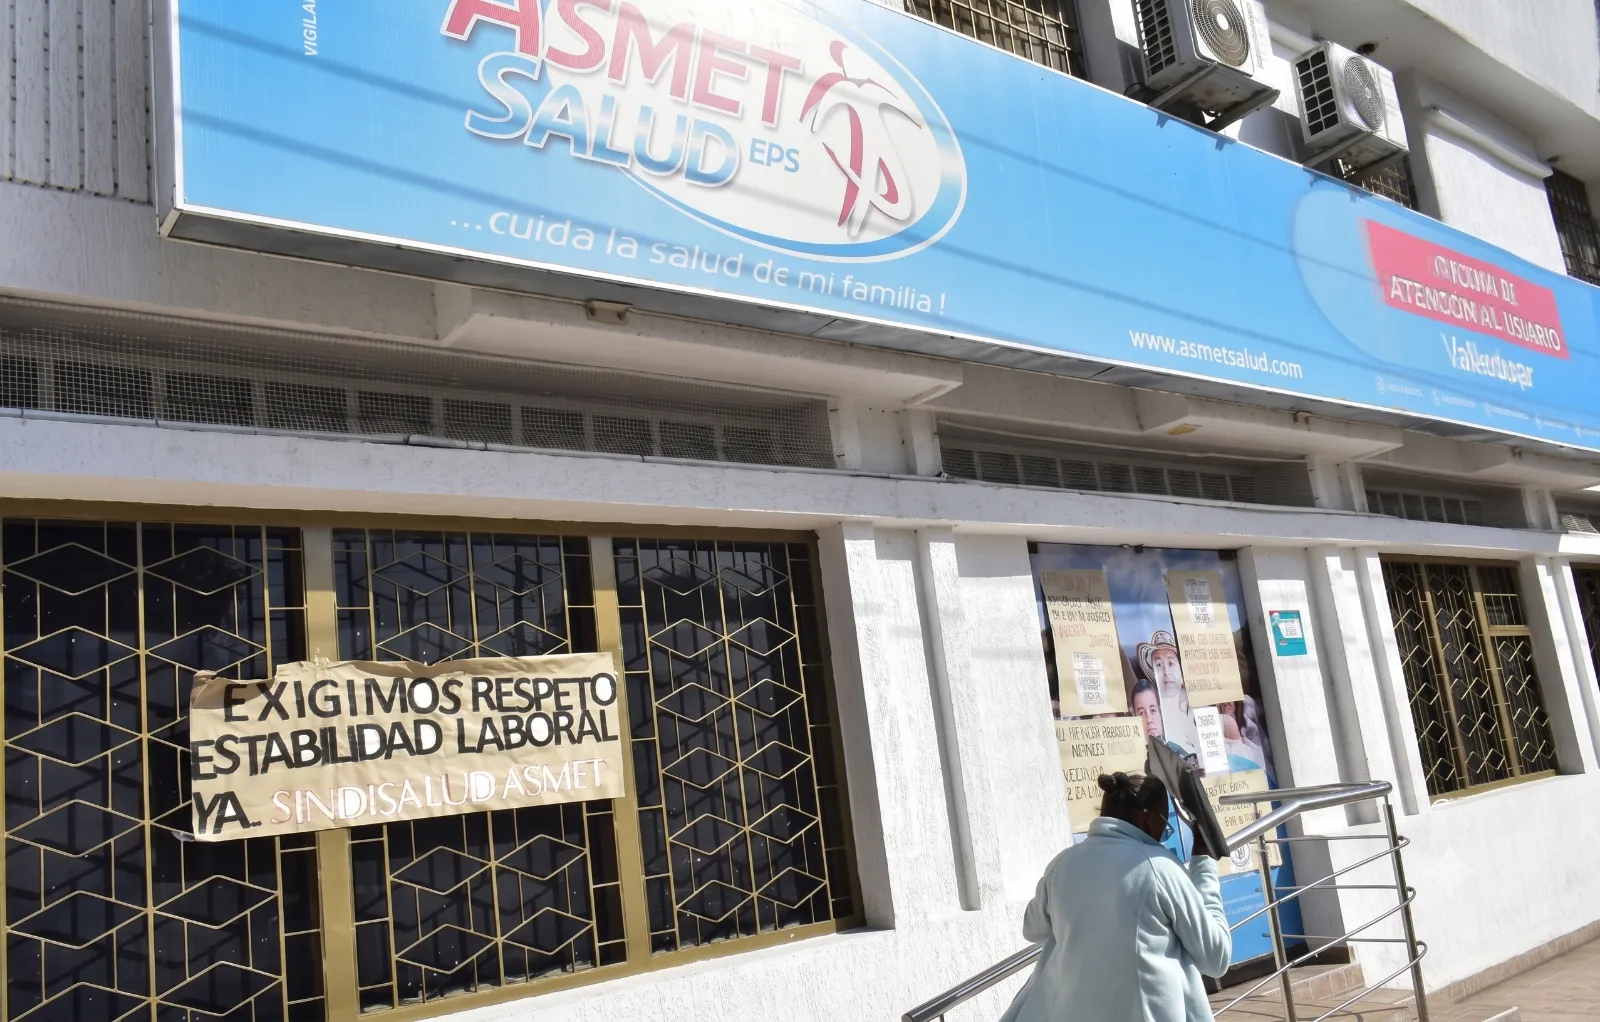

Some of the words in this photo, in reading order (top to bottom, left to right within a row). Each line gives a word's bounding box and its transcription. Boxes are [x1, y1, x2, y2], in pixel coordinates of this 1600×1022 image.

[303, 0, 317, 55] VIGILA
[441, 0, 802, 127] ASMET
[464, 51, 739, 187] SALUD
[750, 139, 800, 173] EPS
[606, 228, 638, 259] la
[649, 243, 743, 278] salud
[752, 259, 788, 287] de
[797, 269, 834, 295] mi
[1129, 329, 1303, 379] www.asmetsalud.com
[1480, 304, 1503, 332] AL
[1503, 311, 1561, 352] USUARIO
[224, 677, 463, 722] EXIGIMOS
[472, 672, 617, 712] RESPETO
[192, 719, 443, 781] ESTABILIDAD
[456, 709, 618, 754] LABORAL
[270, 771, 497, 825] SINDISALUD
[502, 757, 608, 800] ASMET
